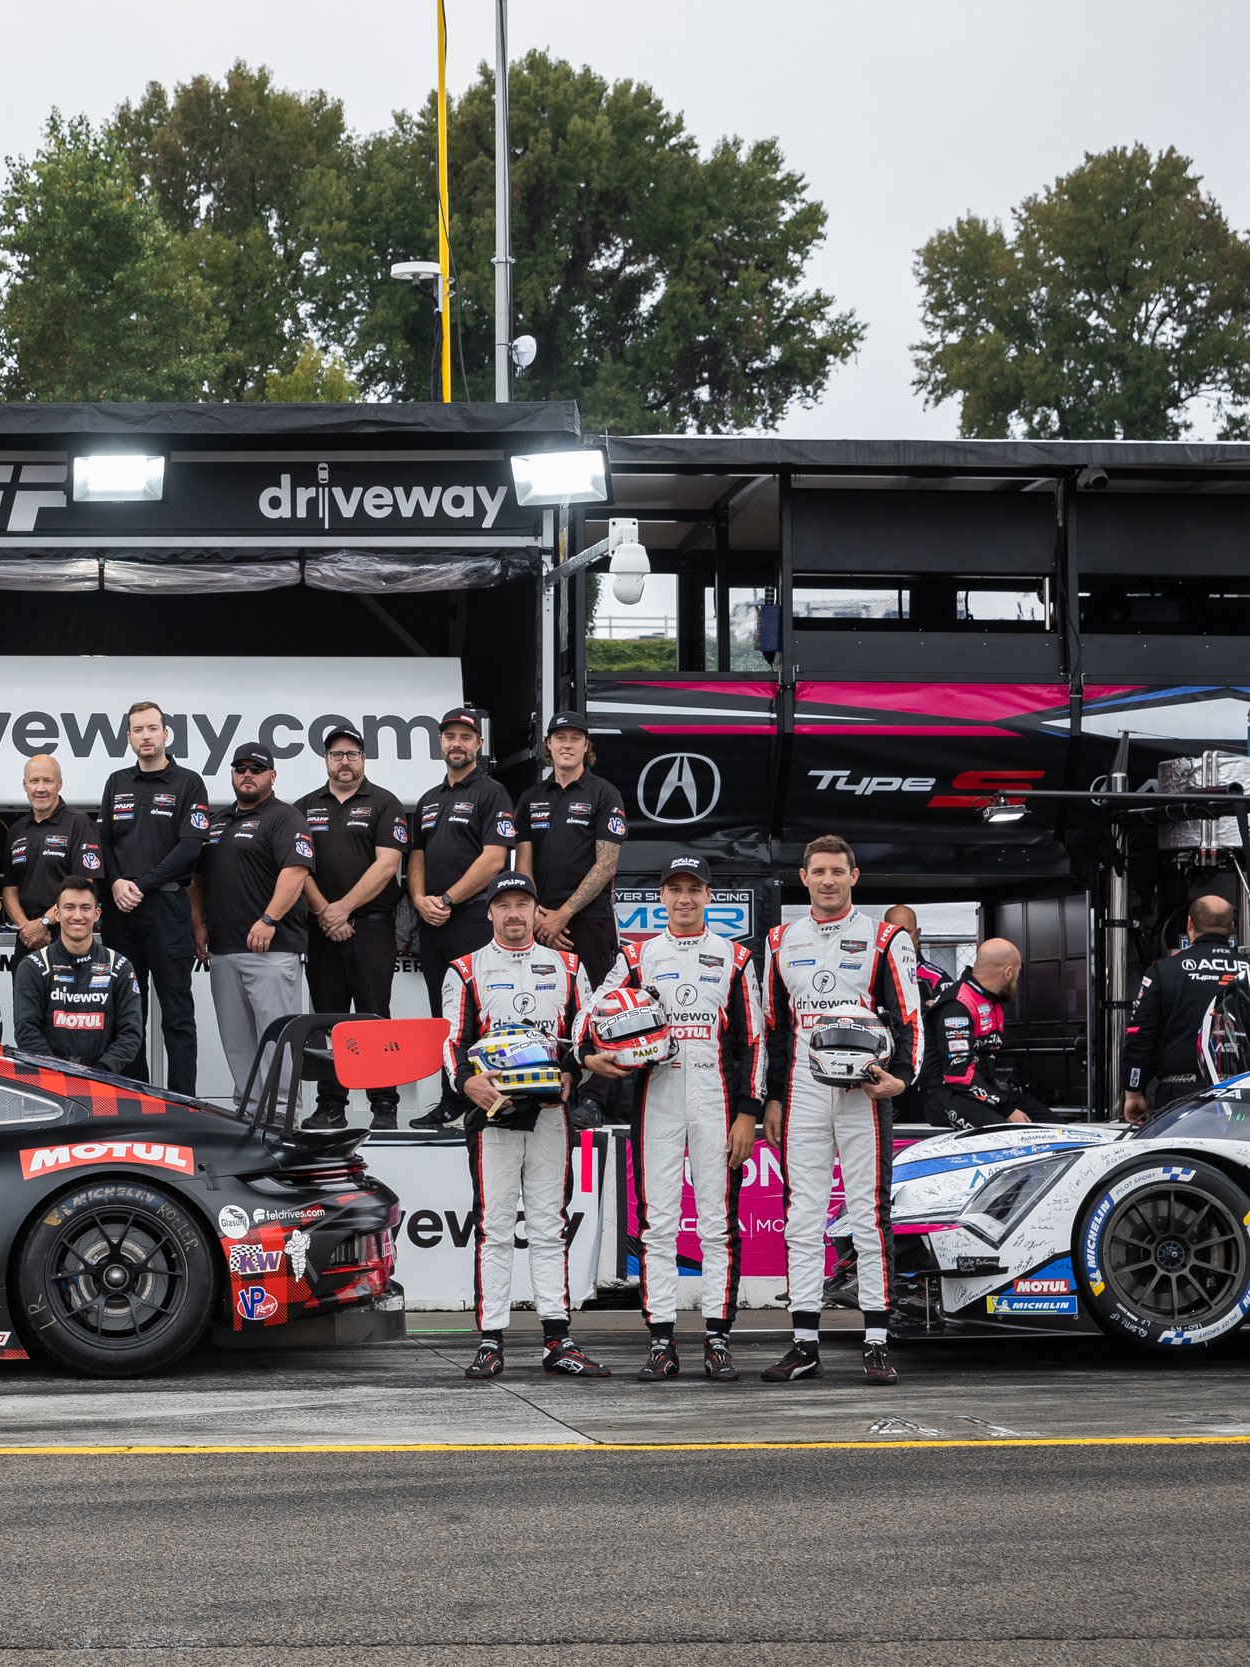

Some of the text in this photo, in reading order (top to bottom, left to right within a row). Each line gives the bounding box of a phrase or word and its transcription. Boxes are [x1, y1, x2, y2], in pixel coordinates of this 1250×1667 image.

[258, 468, 508, 529] driveway
[808, 769, 1045, 808] Type S
[497, 878, 526, 889] PFAFF
[709, 892, 750, 901] ACING
[821, 923, 841, 932] HRX
[879, 923, 894, 942] HRX
[513, 951, 531, 959] HRX
[1188, 972, 1220, 981] Type
[50, 986, 109, 1005] driveway
[55, 1012, 102, 1028] MOTUL
[665, 1005, 718, 1024] riveway
[28, 1143, 188, 1172] MOTUL
[1115, 1173, 1157, 1196] PILOT SPORT
[71, 1186, 157, 1206] MICHELIN
[266, 1208, 326, 1221] feldrives.com
[1087, 1199, 1112, 1268] MICHELIN
[239, 1251, 282, 1275] KW
[1017, 1281, 1068, 1292] MOTUL
[238, 1286, 265, 1319] VP
[255, 1301, 276, 1315] Racing
[1012, 1301, 1070, 1310] MICHELIN
[1198, 1313, 1238, 1338] PILOT SPORT
